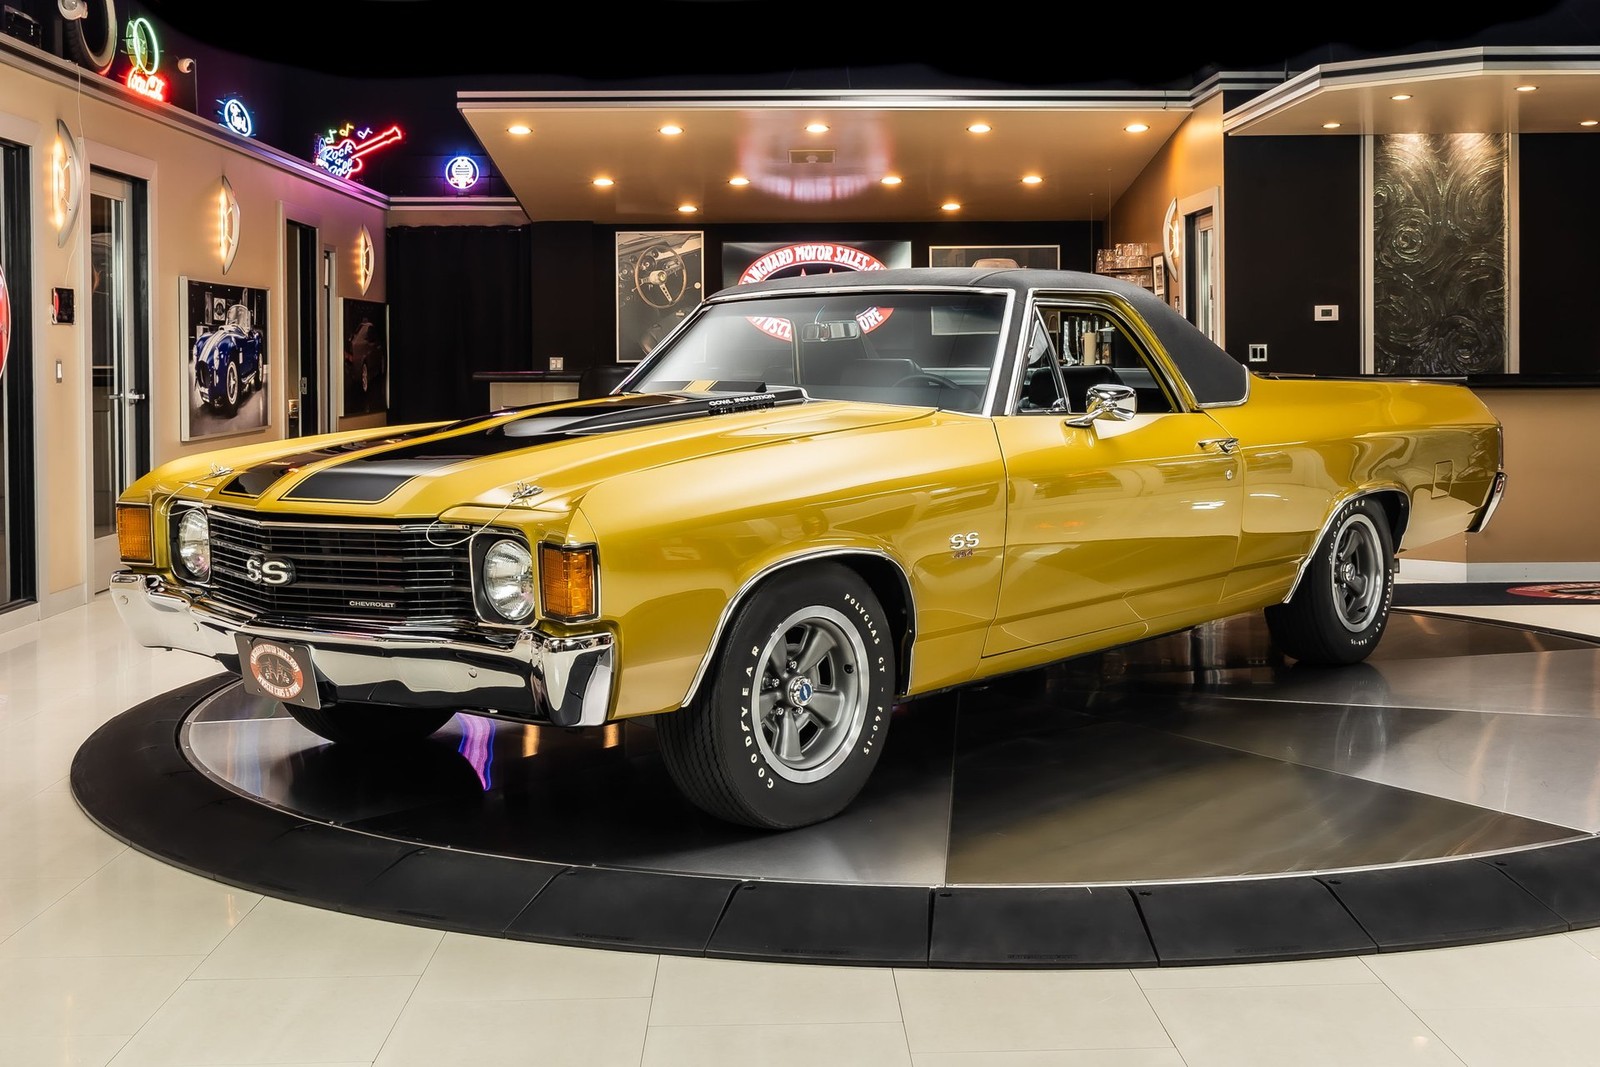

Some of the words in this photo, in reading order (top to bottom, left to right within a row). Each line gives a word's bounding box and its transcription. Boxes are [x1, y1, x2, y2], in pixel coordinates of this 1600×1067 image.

[325, 141, 352, 161] Rock
[742, 250, 793, 284] ANGUARD
[794, 245, 833, 262] MOTOR
[858, 306, 884, 331] ORE
[735, 394, 776, 404] INDUCTION
[949, 532, 979, 550] SS
[247, 558, 289, 584] SS
[349, 600, 395, 608] CHEVROLET
[844, 593, 880, 644] POLYGLAS
[878, 657, 885, 672] GT
[741, 646, 774, 788] GOODYEAR
[864, 706, 883, 755] F60-15
